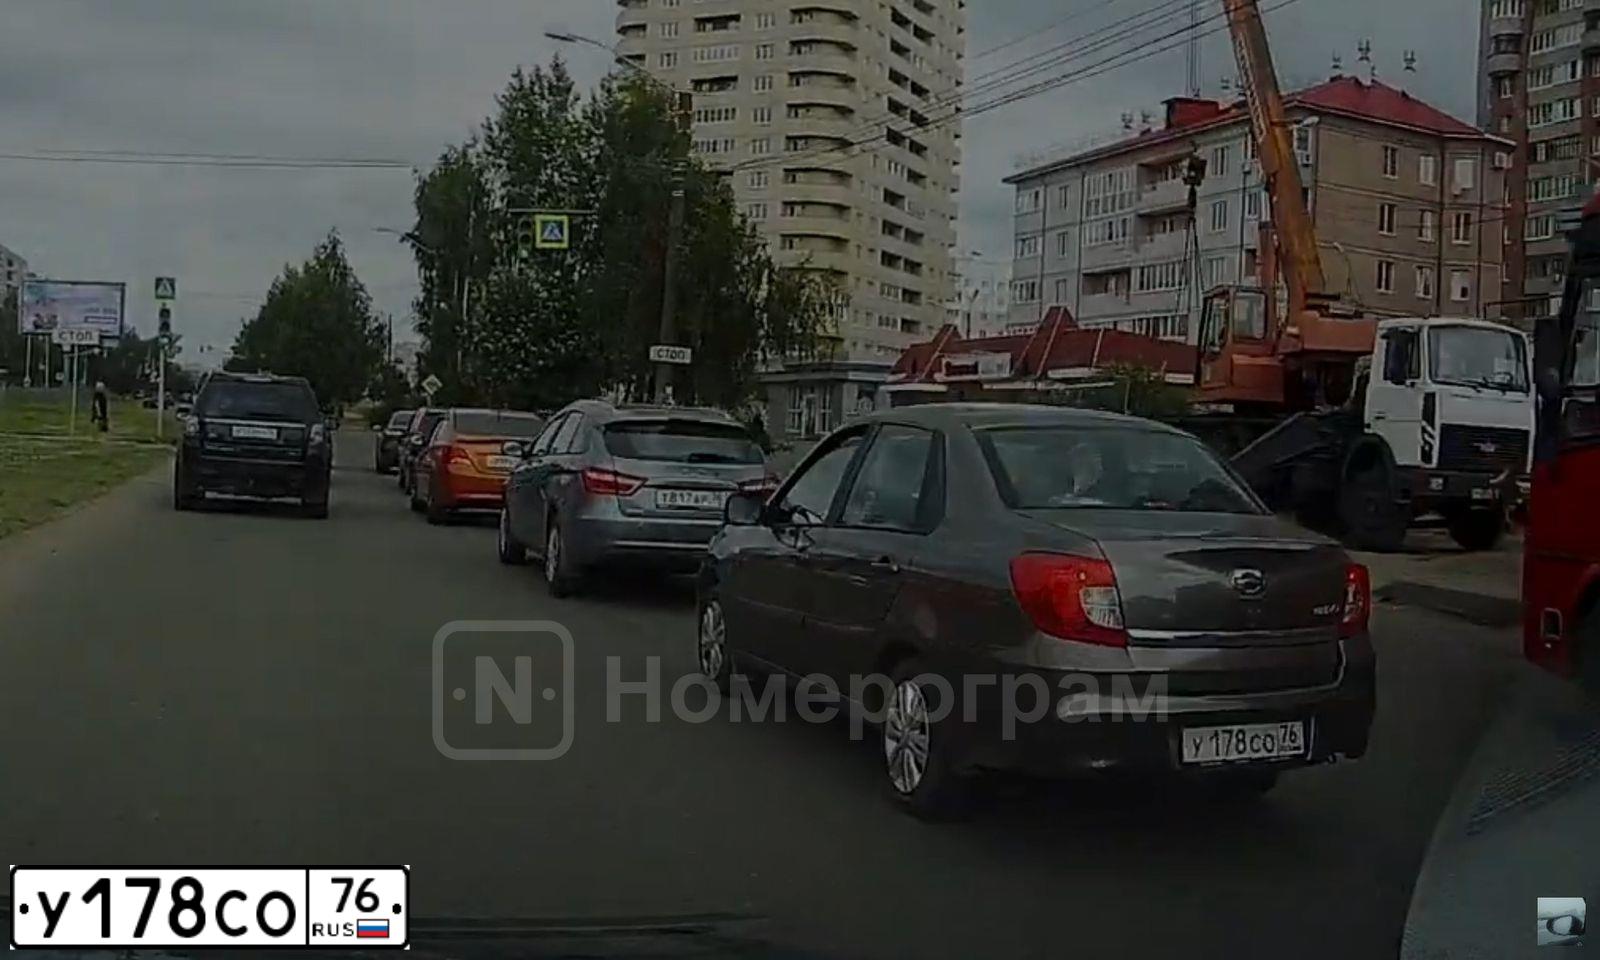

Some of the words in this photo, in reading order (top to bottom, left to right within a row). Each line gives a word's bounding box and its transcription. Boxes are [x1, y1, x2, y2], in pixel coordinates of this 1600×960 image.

[58, 330, 93, 342] СТОП
[656, 347, 686, 361] СТОП
[1279, 724, 1298, 743] 76
